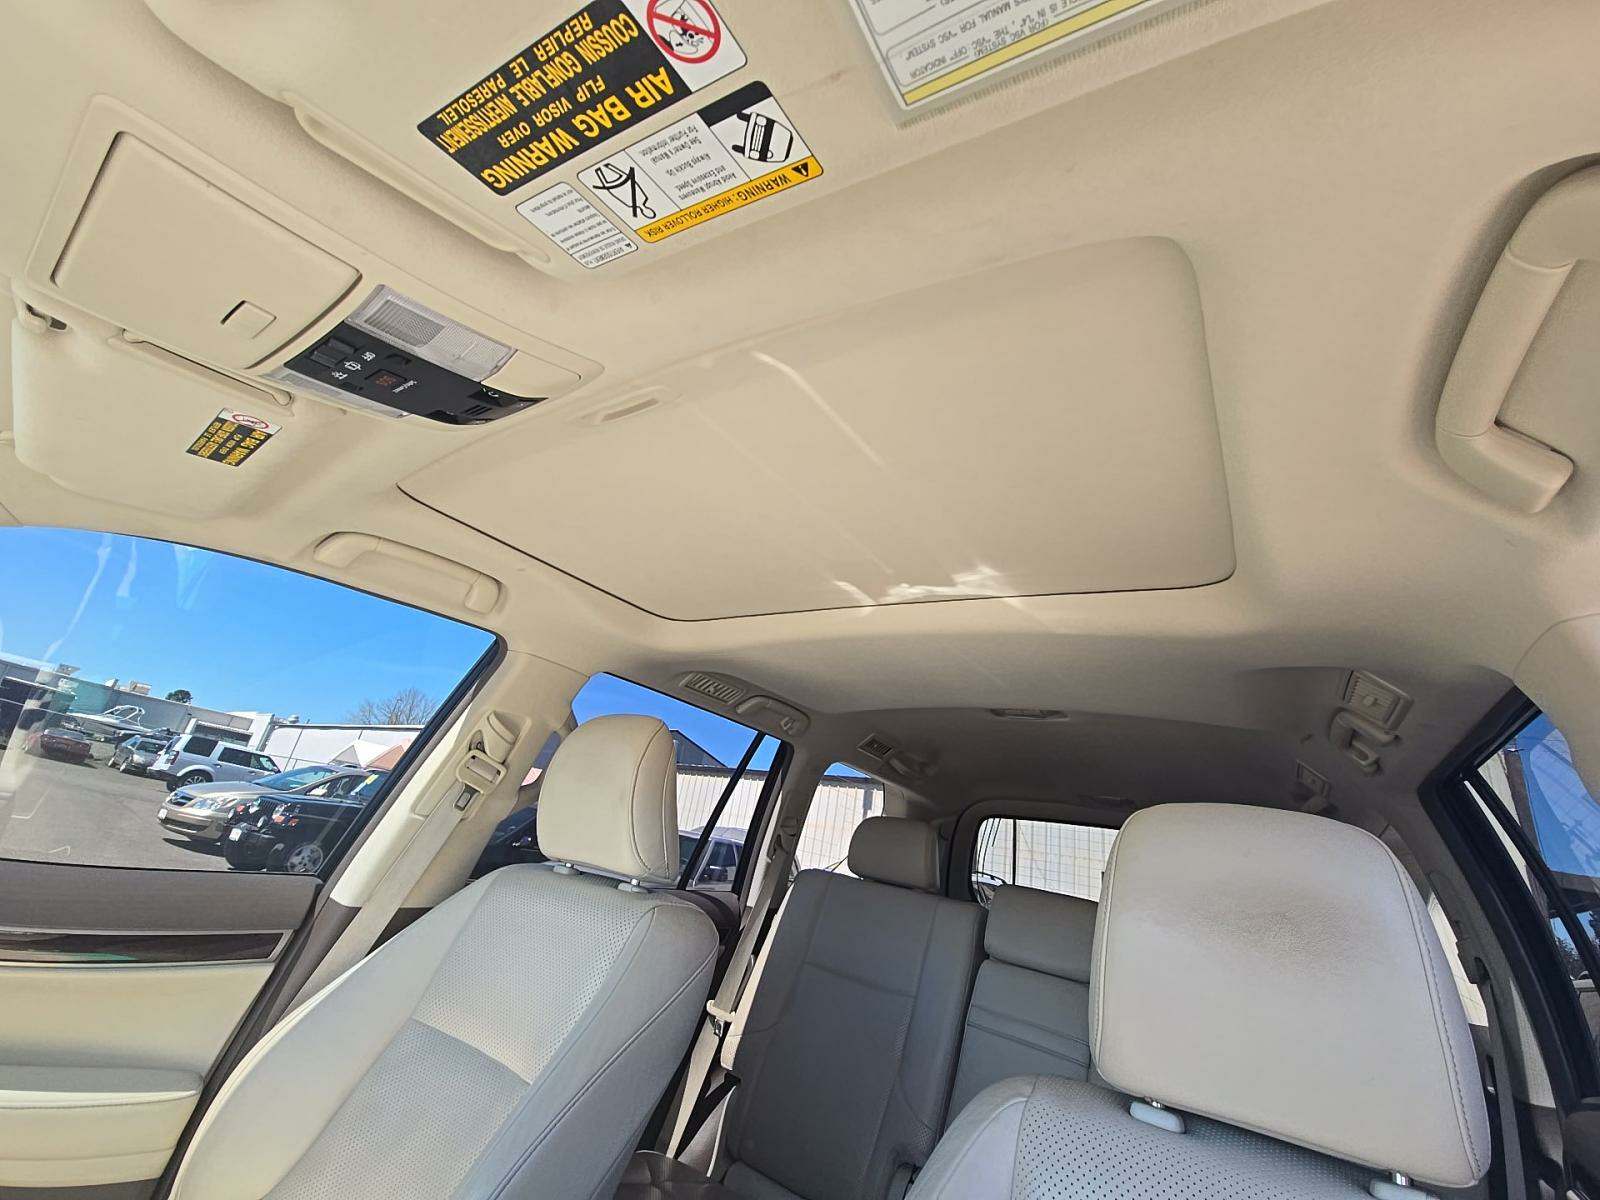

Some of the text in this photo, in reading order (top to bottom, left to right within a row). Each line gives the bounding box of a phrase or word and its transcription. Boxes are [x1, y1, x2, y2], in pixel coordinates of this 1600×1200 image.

[435, 10, 593, 127] REPLIER LE PARESOLEIL
[435, 10, 640, 154] COUSSIN GONFLABLE AVERTISSEMENT
[496, 73, 606, 148] FLIP VISOR OVER
[479, 65, 675, 191] AIR BAG WARNING
[644, 171, 791, 236] WARNING: HIGHER ROLLOVER RISK
